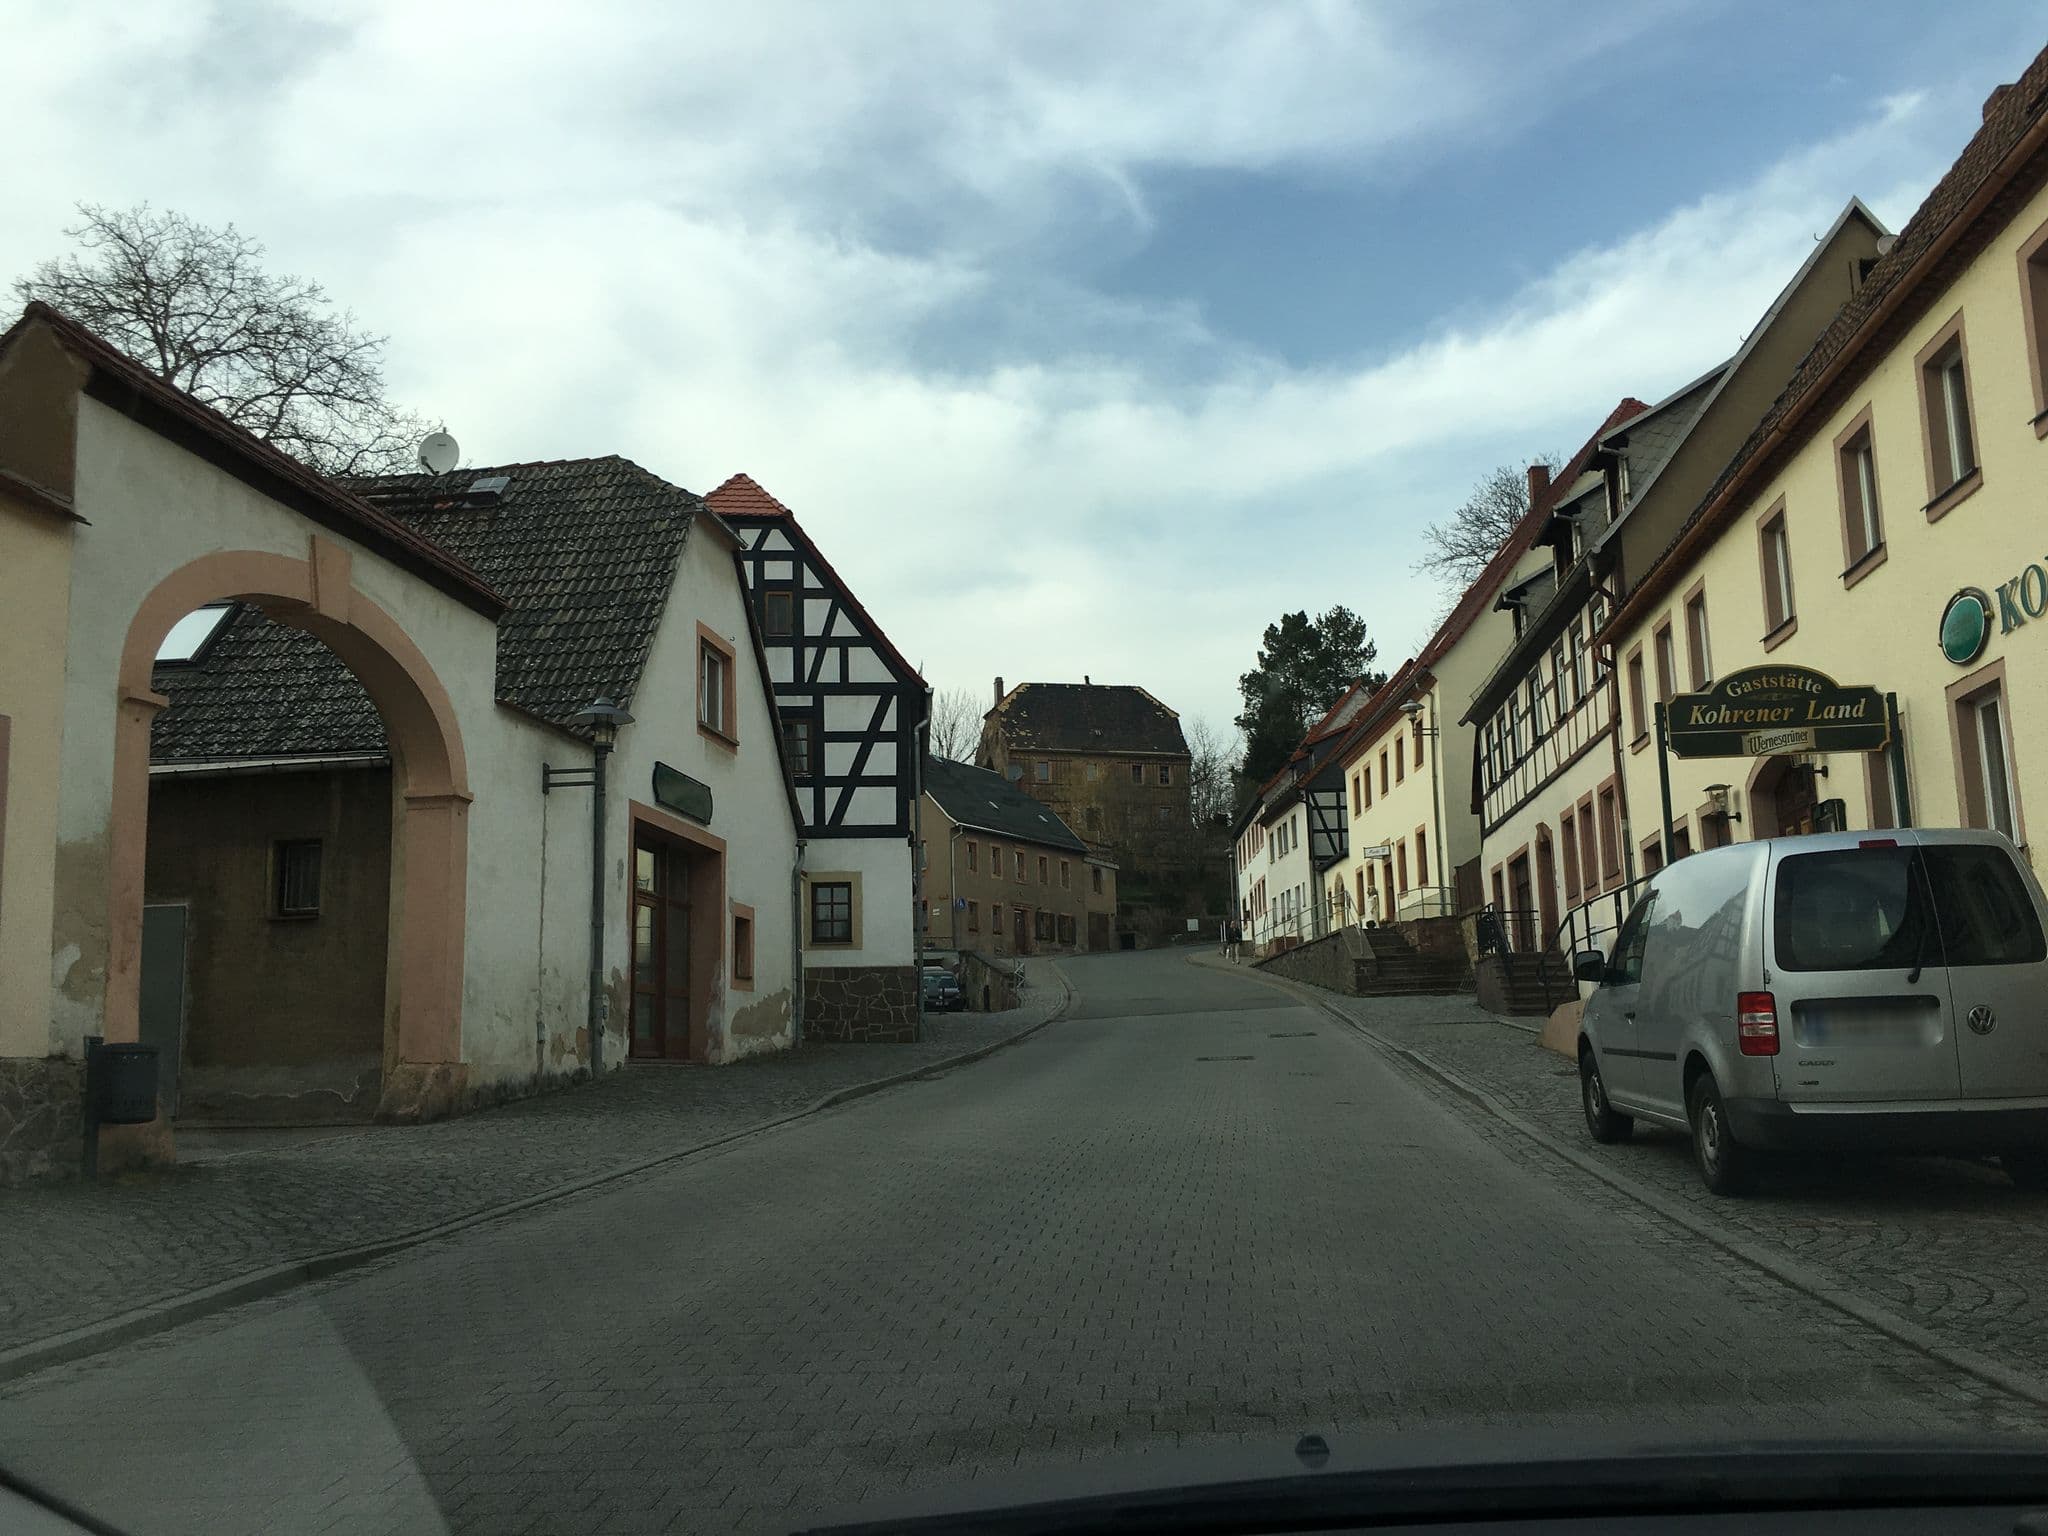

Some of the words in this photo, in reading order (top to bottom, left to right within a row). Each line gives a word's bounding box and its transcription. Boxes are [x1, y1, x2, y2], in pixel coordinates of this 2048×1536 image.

[1995, 556, 2048, 635] KO
[1725, 673, 1823, 698] Gaststätte
[1688, 704, 1795, 726] Kohrener
[1806, 697, 1867, 721] Land
[1748, 730, 1808, 755] Wernesgrüner
